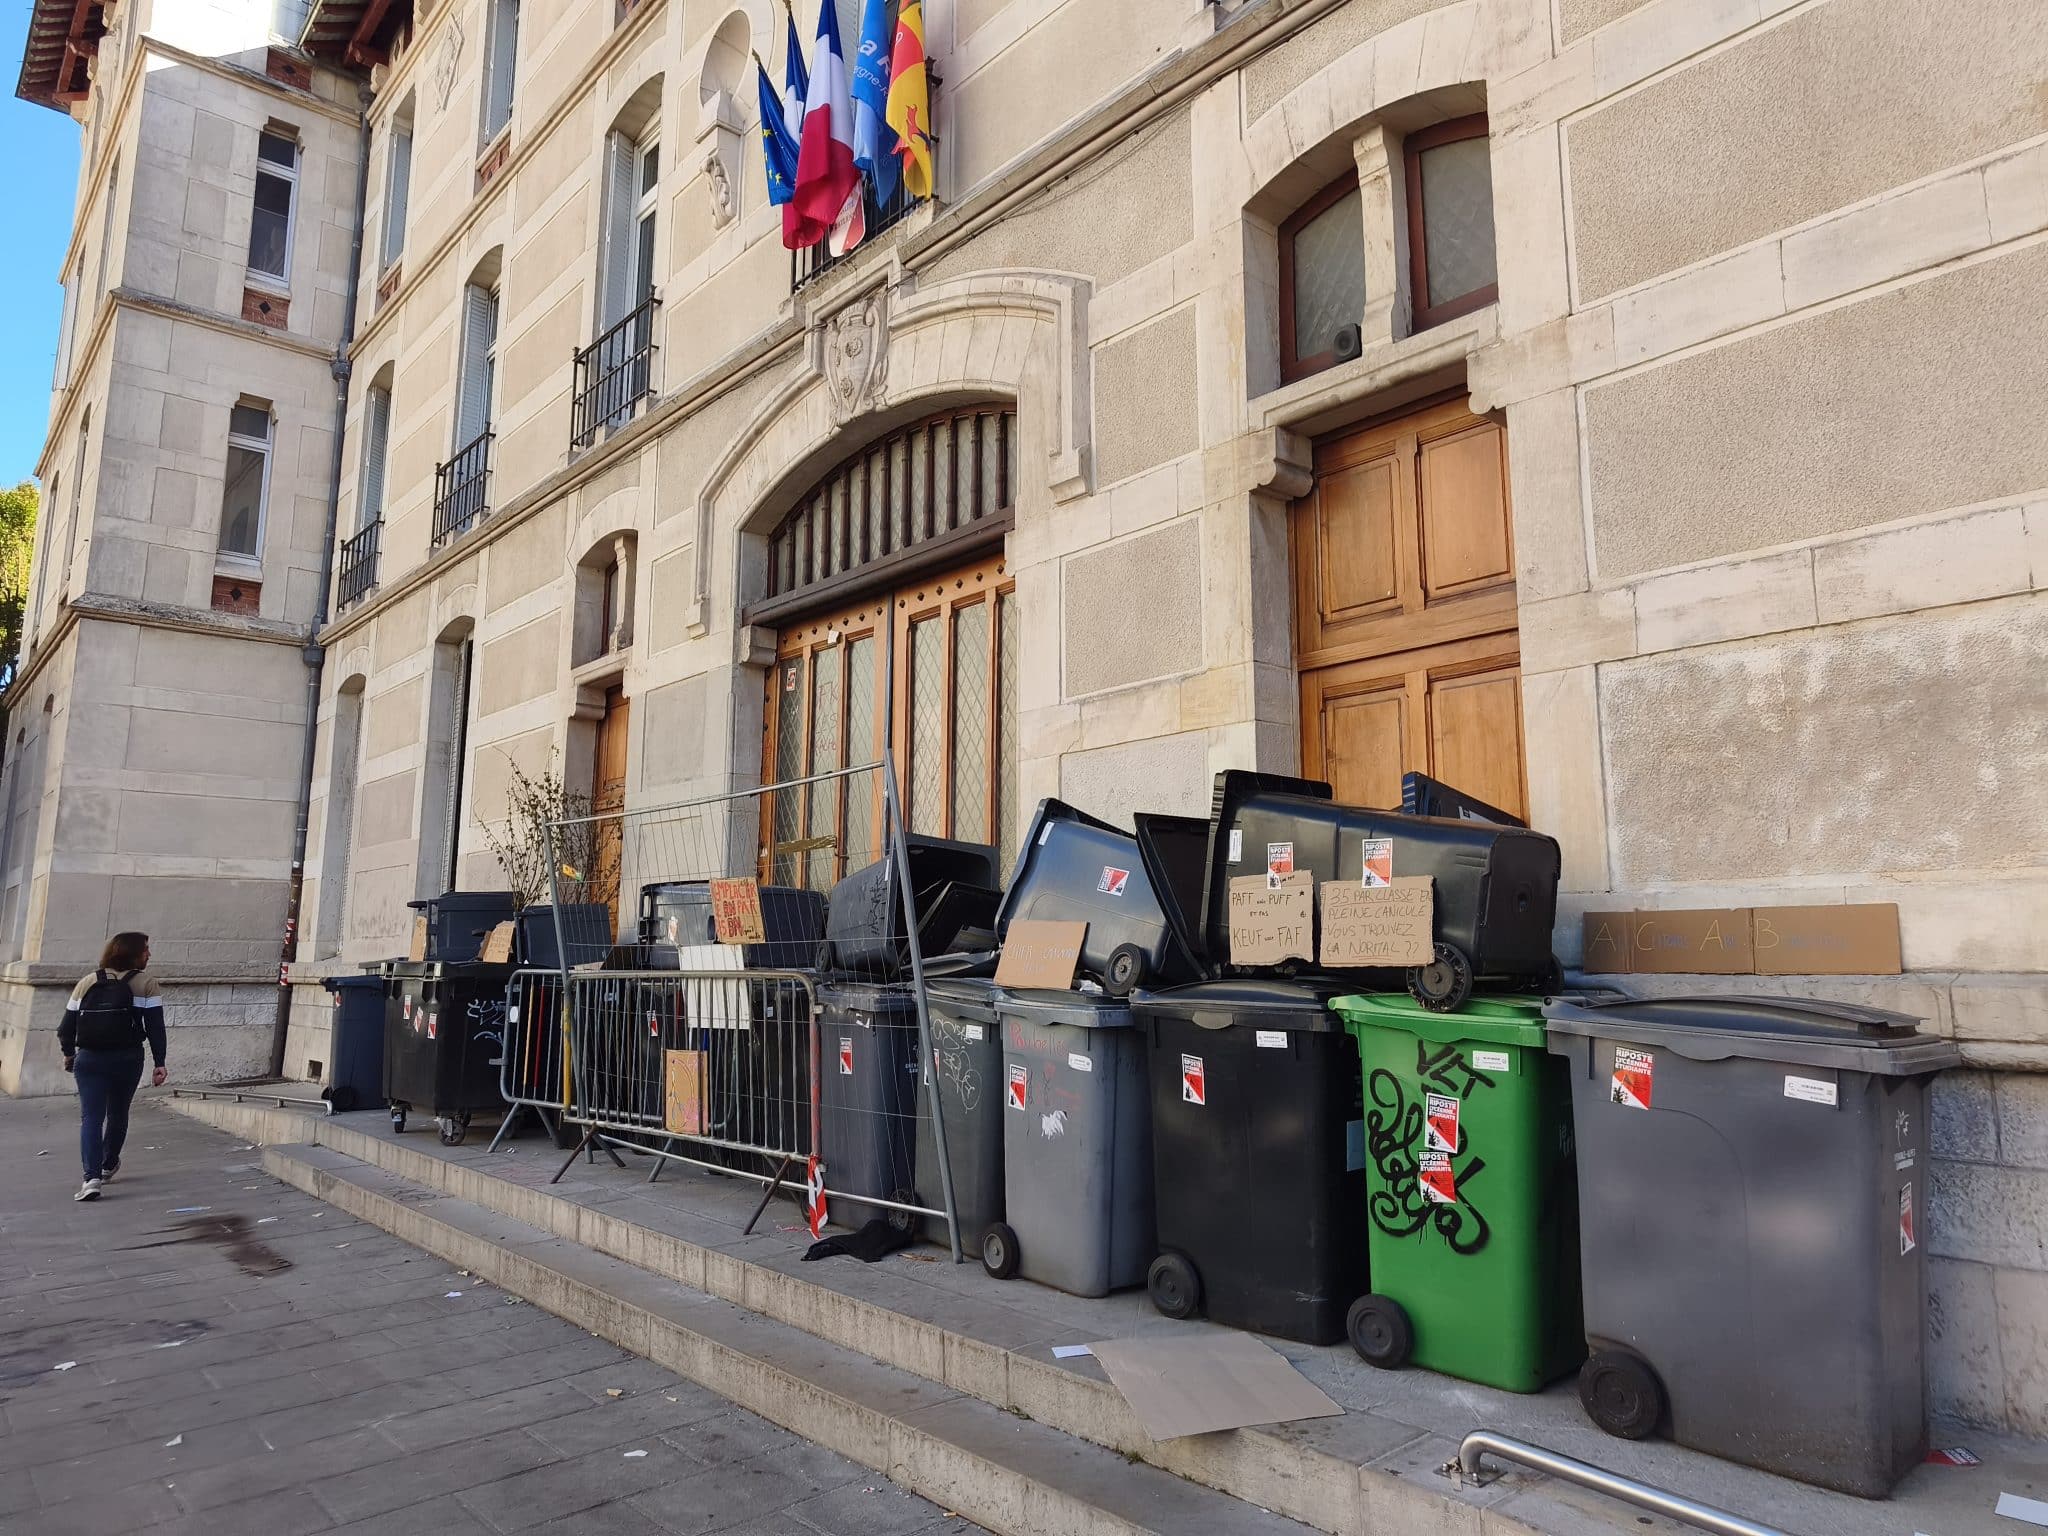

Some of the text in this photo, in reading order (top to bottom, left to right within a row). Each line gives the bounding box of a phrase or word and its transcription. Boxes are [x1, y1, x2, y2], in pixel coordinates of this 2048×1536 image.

[1268, 893, 1292, 906] PUFF
[1330, 888, 1350, 905] 35
[1353, 890, 1374, 902] PAR
[1375, 888, 1419, 902] CLASSE
[1328, 905, 1426, 920] PLEINE CANICULE
[1233, 925, 1303, 949] KEUF FAF
[1326, 921, 1416, 938] VOUS TROUVEZ
[1349, 941, 1400, 956] NORMAL
[1616, 1049, 1653, 1063] RIPOSTE
[1429, 1097, 1457, 1110] RIPOSTE
[1419, 1153, 1449, 1161] RIPOSTE
